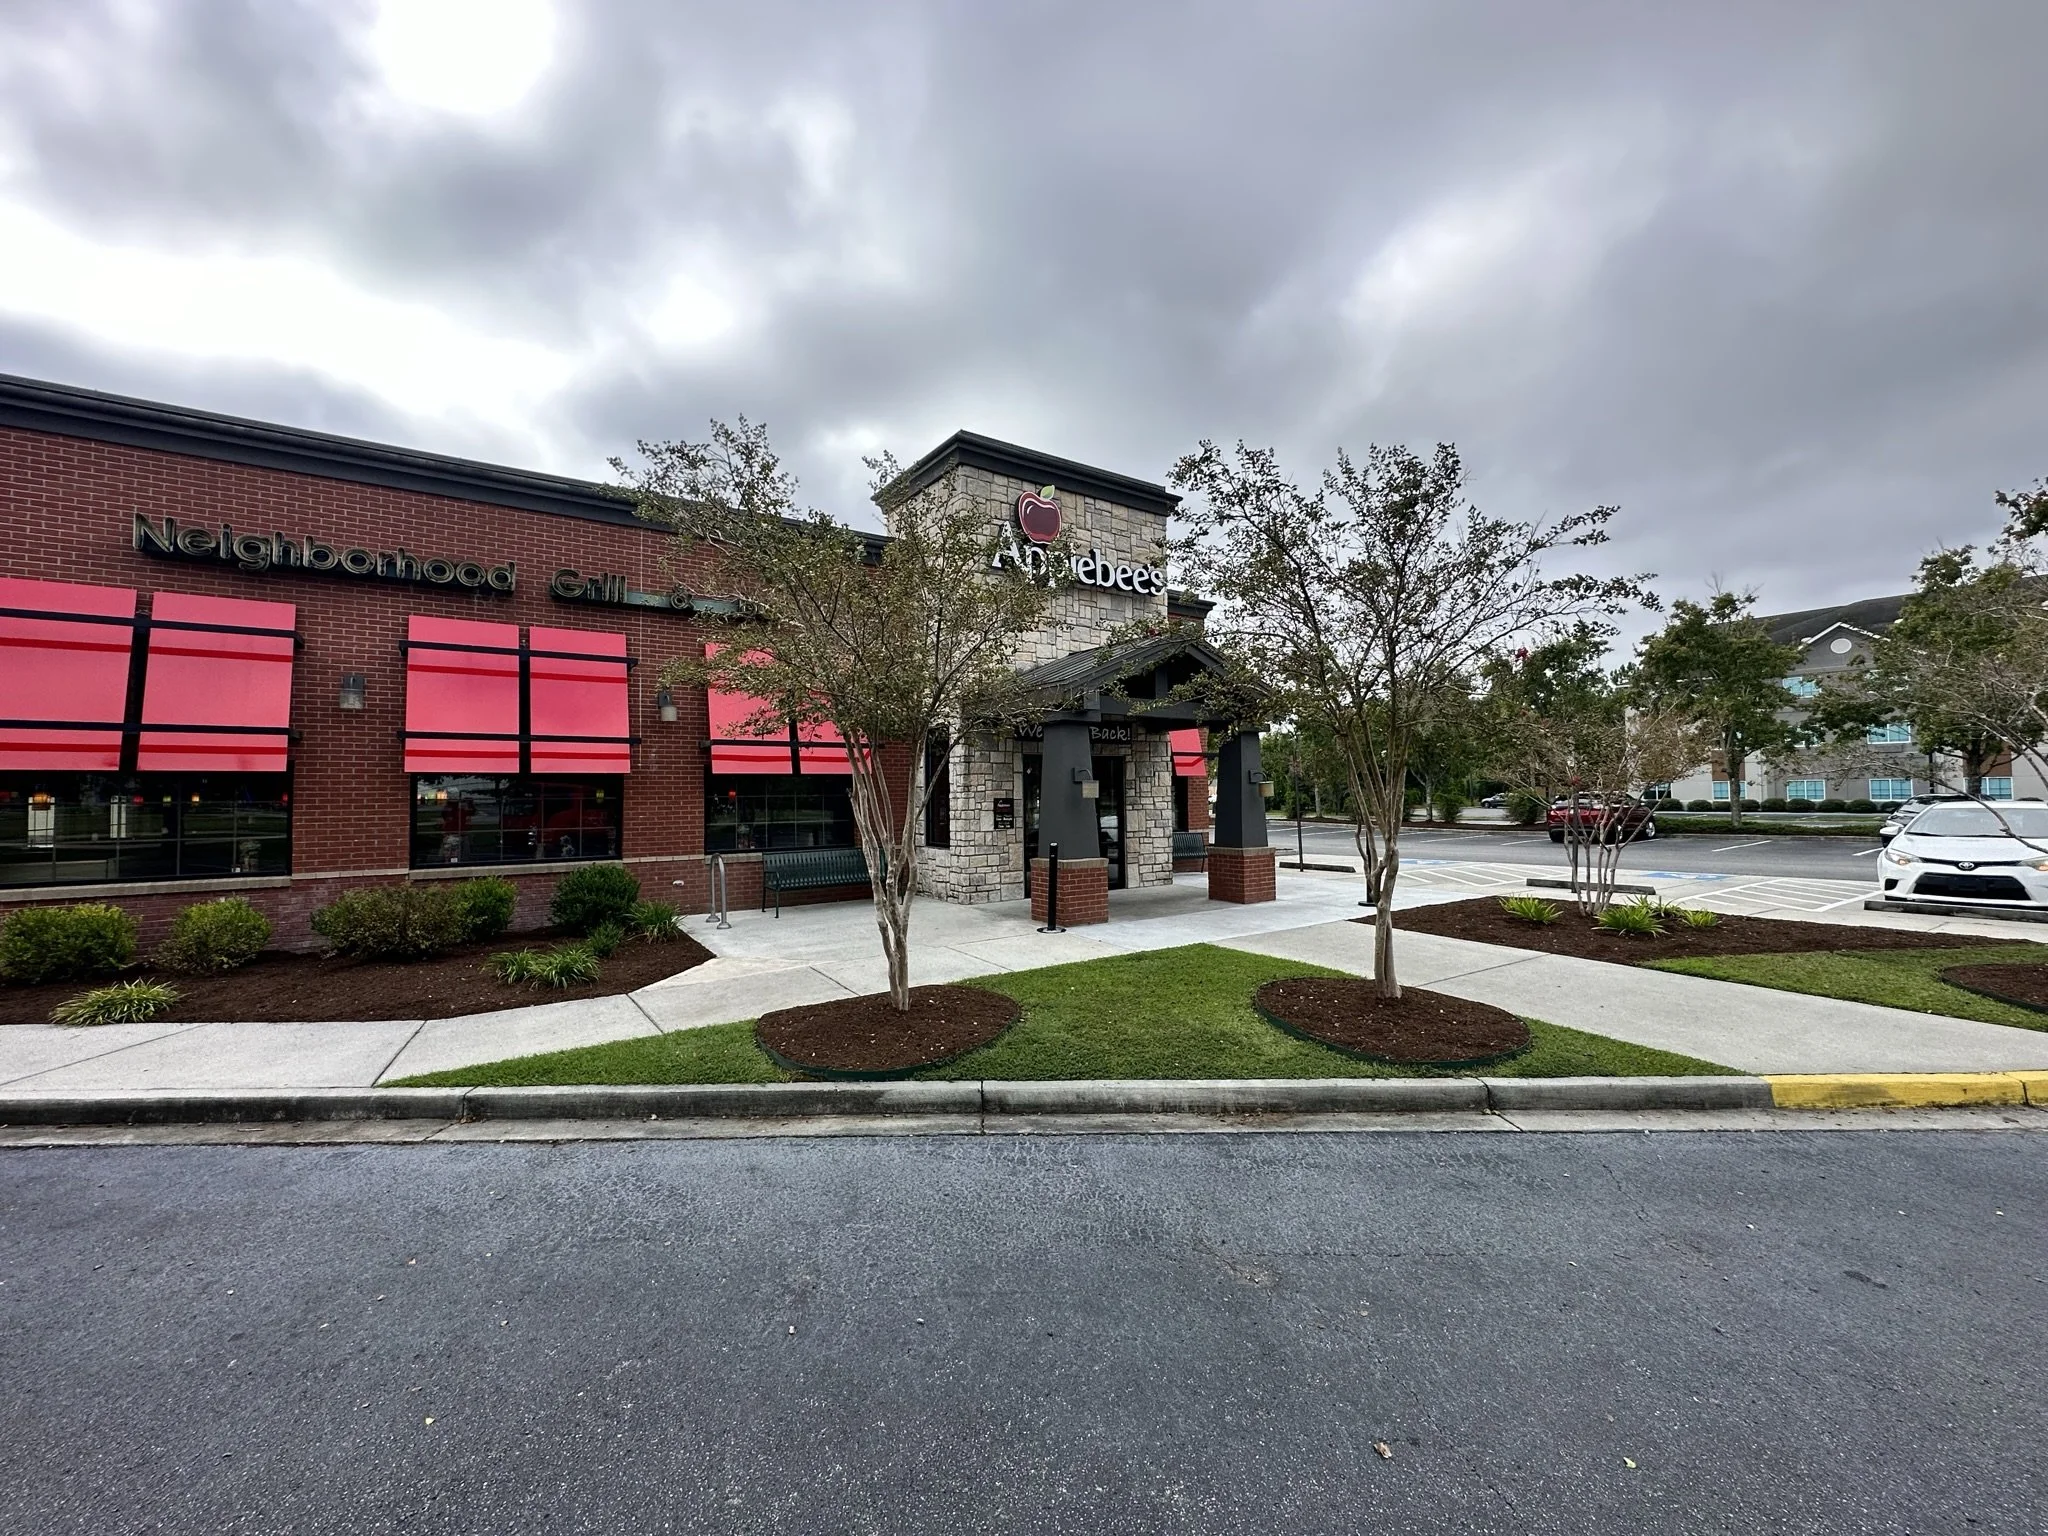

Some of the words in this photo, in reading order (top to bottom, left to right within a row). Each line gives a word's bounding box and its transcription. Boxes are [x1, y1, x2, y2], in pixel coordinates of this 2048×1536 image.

[132, 512, 517, 592] Neighborhood
[551, 568, 627, 604] Grill
[1088, 726, 1131, 741] Back!
